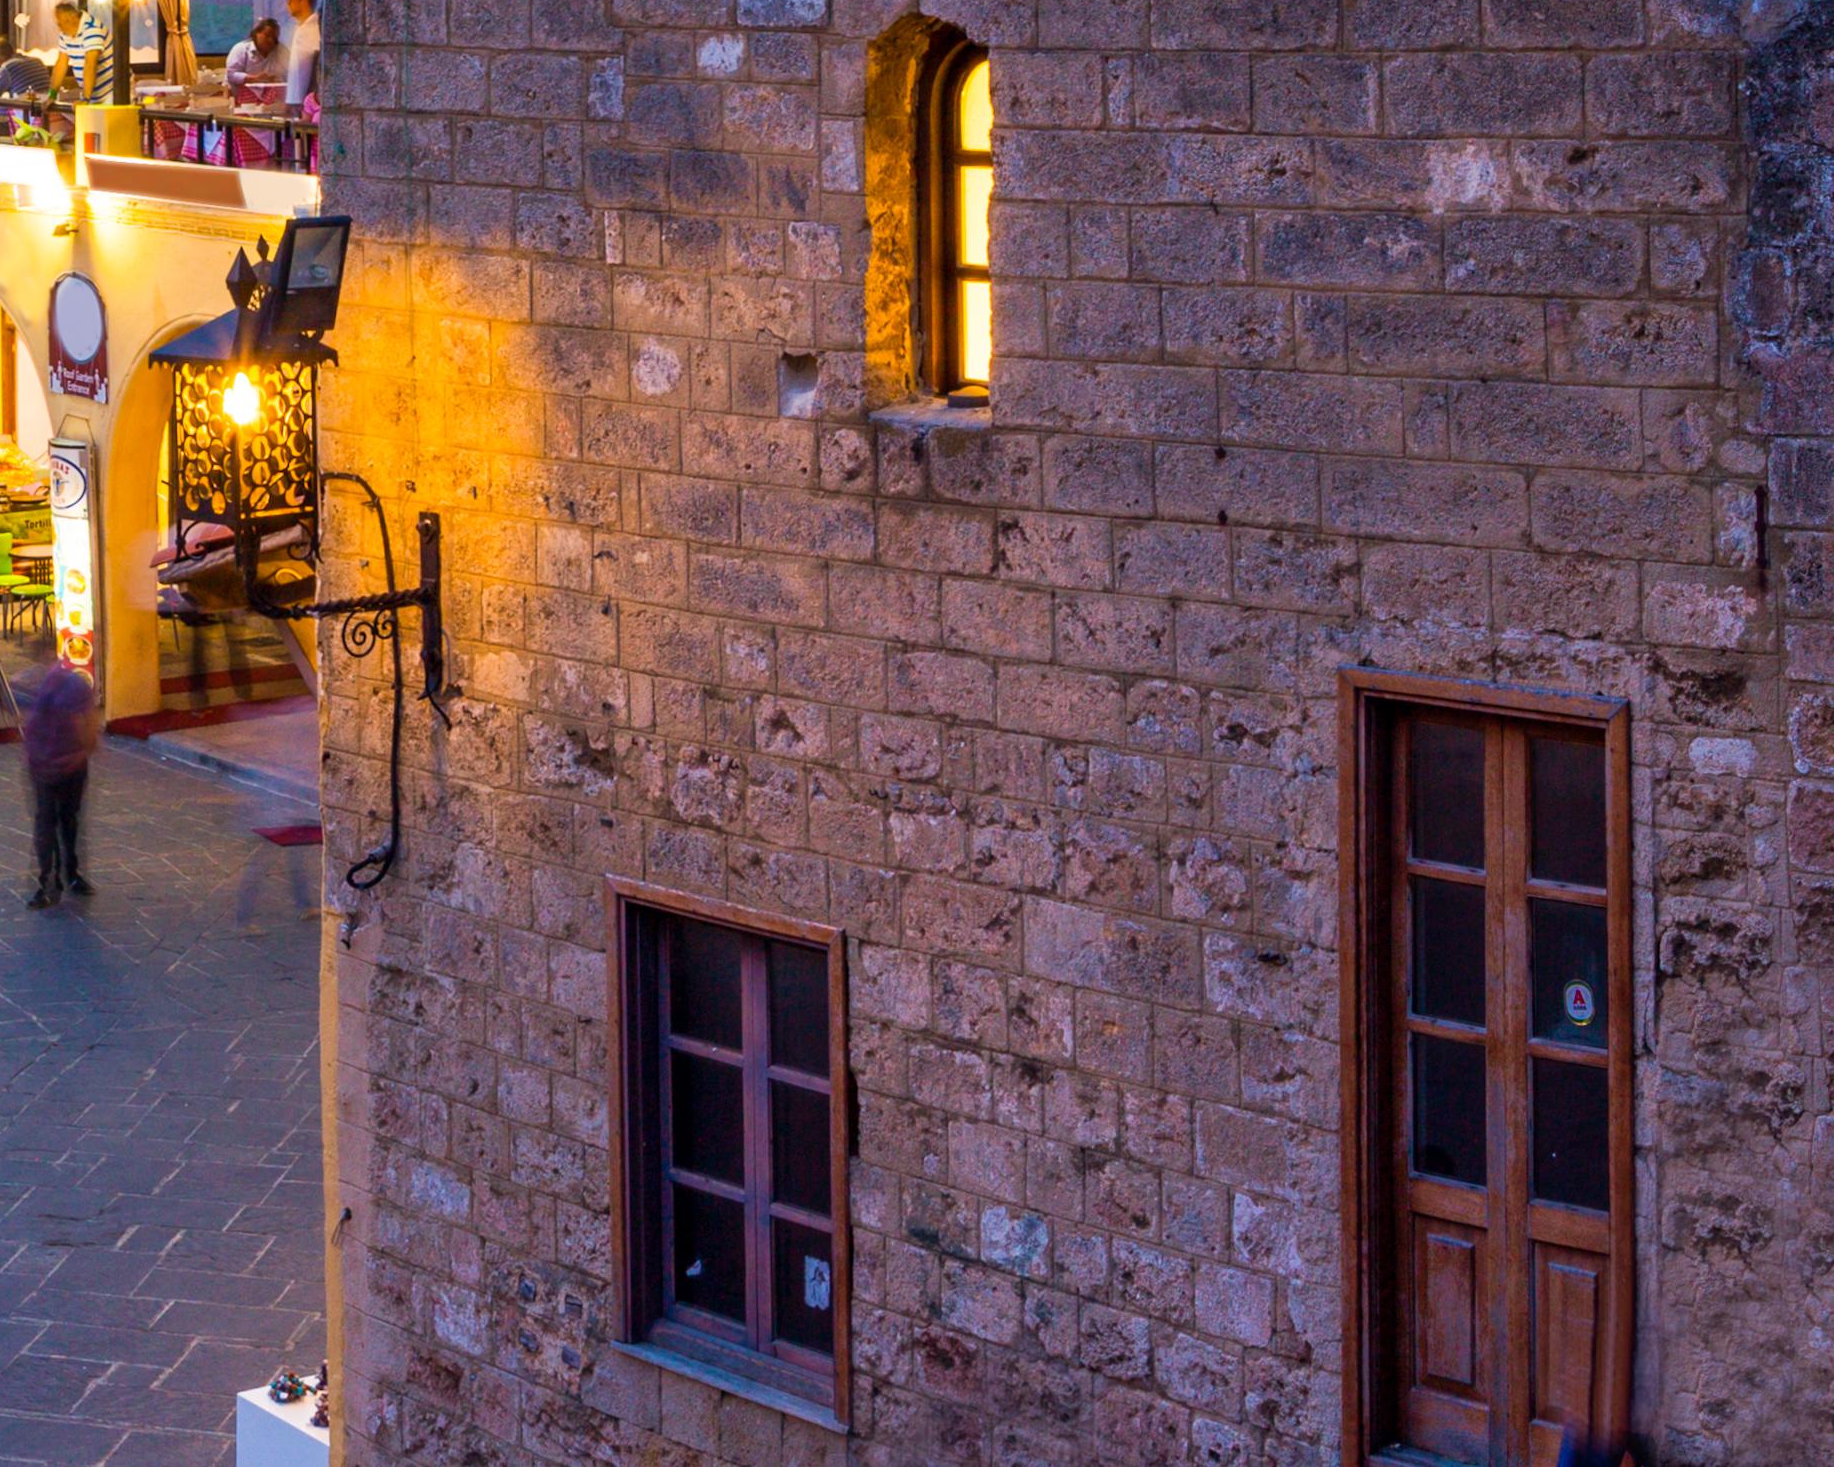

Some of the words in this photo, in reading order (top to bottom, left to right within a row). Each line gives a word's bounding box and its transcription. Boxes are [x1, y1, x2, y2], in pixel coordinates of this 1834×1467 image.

[63, 367, 75, 379] Roof
[75, 370, 94, 384] Garden
[67, 380, 90, 395] Entrance
